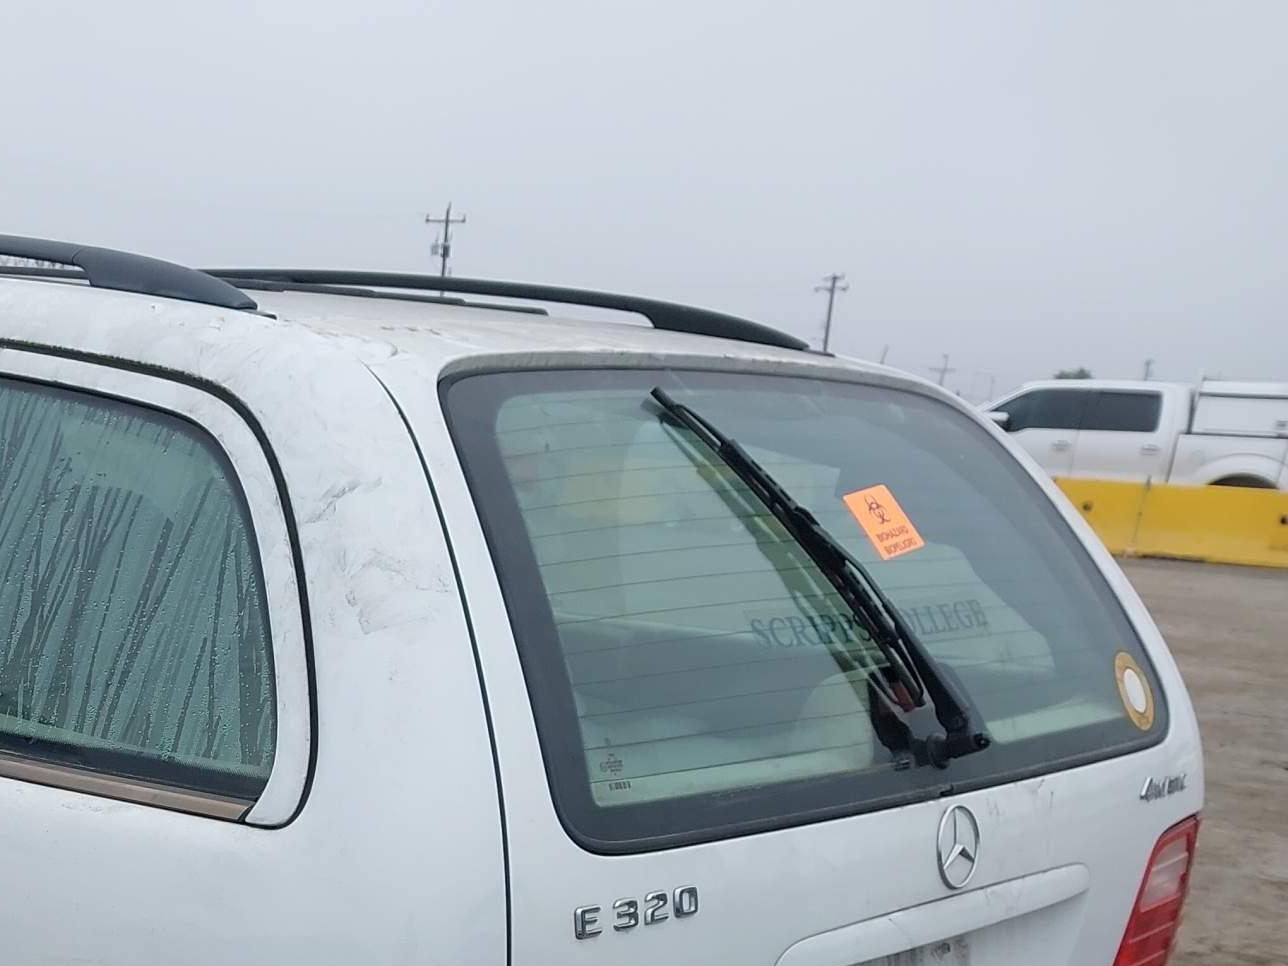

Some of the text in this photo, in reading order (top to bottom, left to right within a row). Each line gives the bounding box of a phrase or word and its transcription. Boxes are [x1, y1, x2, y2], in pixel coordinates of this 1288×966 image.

[899, 599, 988, 635] LLEGE
[574, 884, 699, 940] E 320
